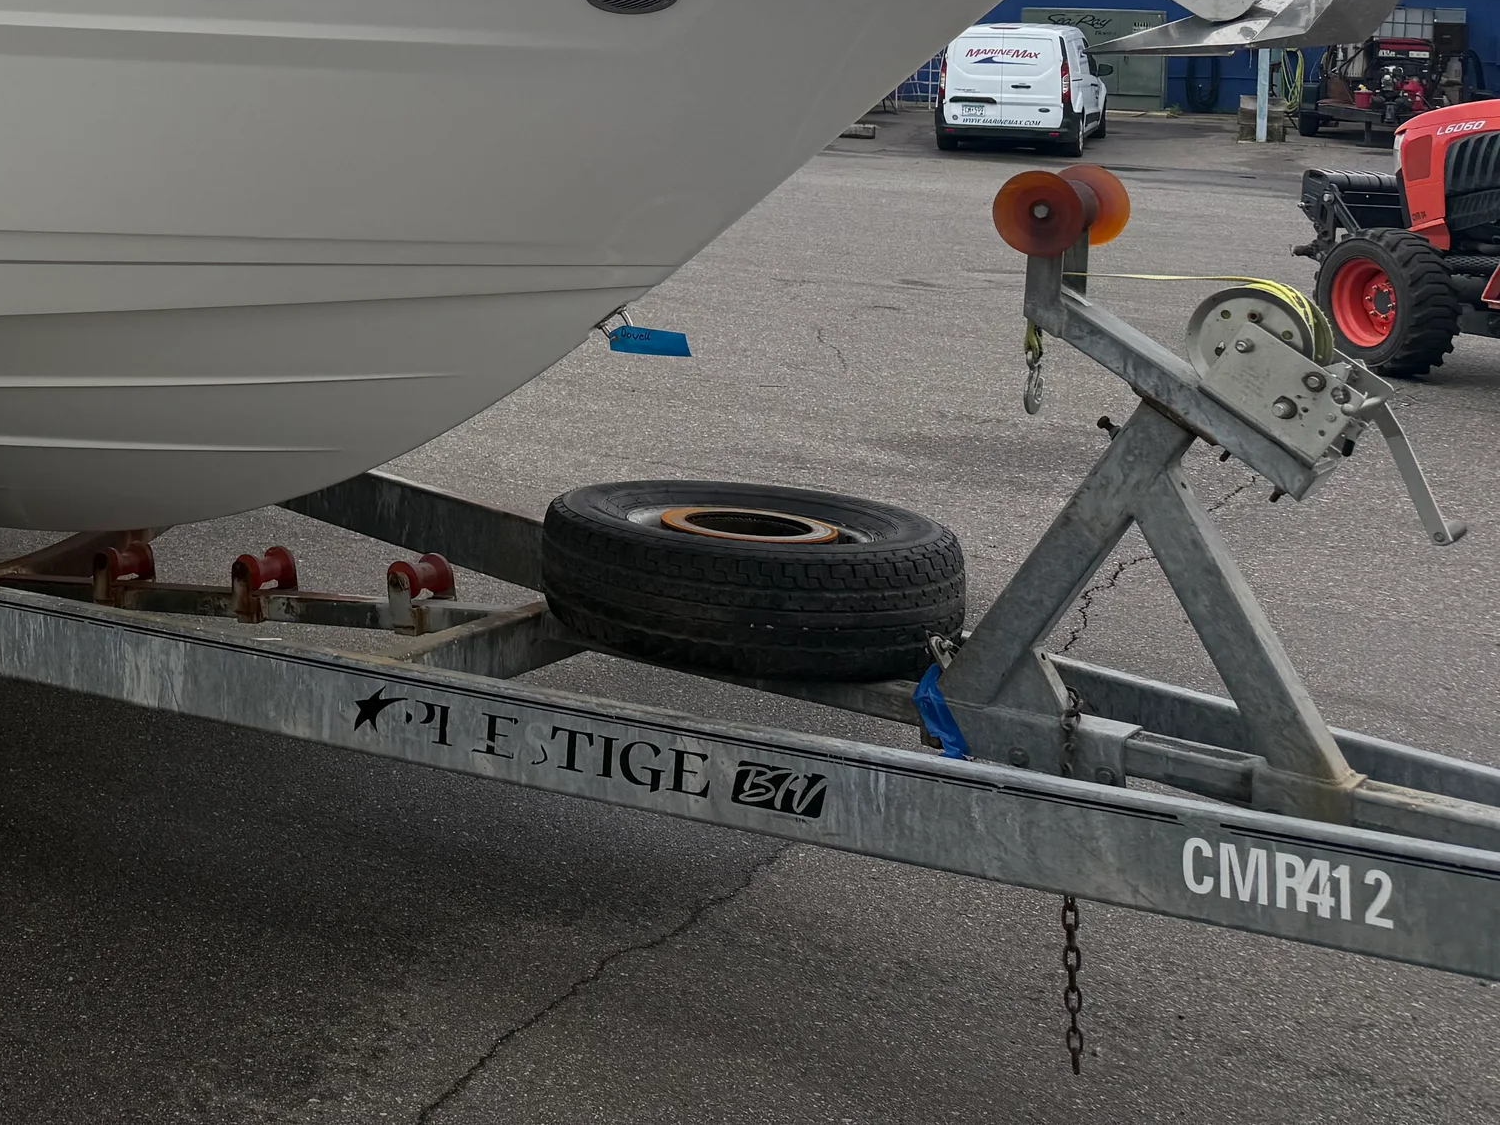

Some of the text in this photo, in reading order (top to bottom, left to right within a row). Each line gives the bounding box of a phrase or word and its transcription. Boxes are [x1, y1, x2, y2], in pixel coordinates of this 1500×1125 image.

[1047, 13, 1112, 29] Sea Ray
[1436, 120, 1486, 136] L6060
